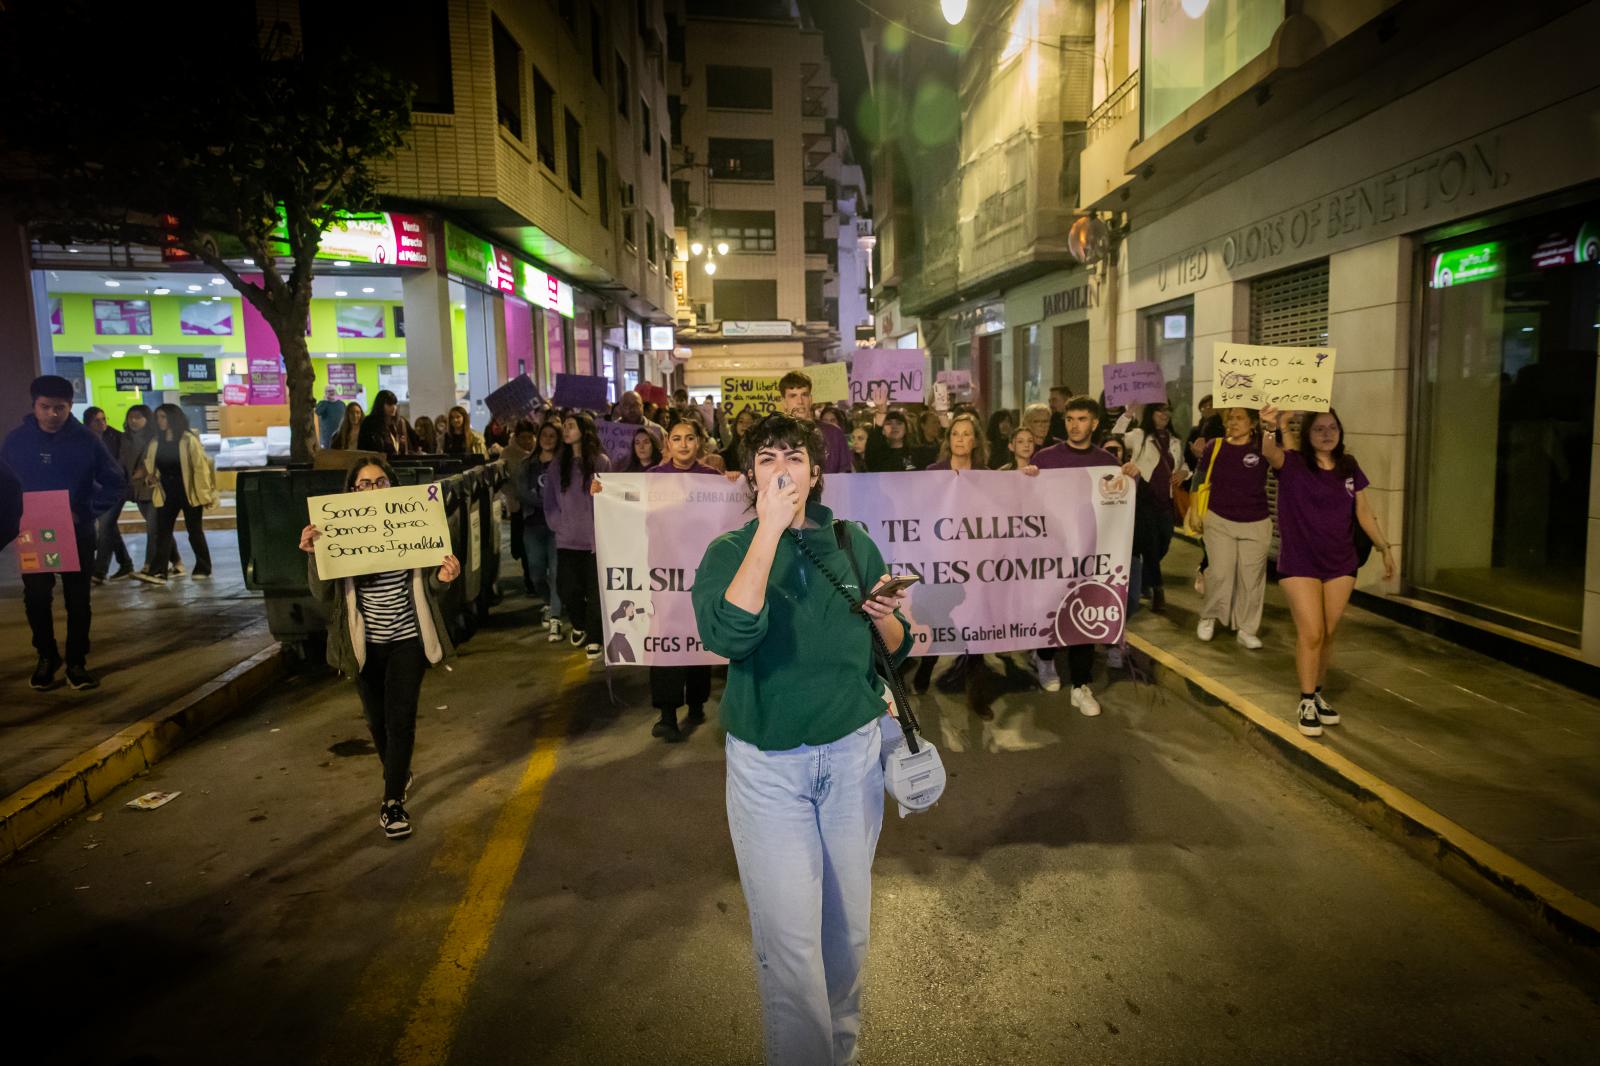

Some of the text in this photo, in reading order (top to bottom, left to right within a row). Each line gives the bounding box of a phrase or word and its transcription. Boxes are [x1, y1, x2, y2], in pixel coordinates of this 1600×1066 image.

[402, 221, 420, 233] Venta
[1290, 204, 1321, 249] OF
[188, 363, 207, 371] BLACK
[1220, 350, 1279, 368] Levanto
[188, 371, 208, 379] FRIDAY
[1262, 377, 1288, 389] por
[322, 502, 377, 520] Somos
[324, 519, 430, 538] Somos fuerza
[881, 519, 920, 542] TE
[934, 515, 1049, 542] CALLES!
[327, 536, 444, 558] Somos Igualdad
[606, 567, 642, 591] EL
[649, 567, 696, 592] SIL
[933, 561, 971, 585] ES
[1083, 605, 1120, 622] 016
[643, 636, 681, 652] CFGS
[932, 627, 956, 642] IES
[961, 624, 1006, 642] Gabriel
[1010, 622, 1037, 639] Miró
